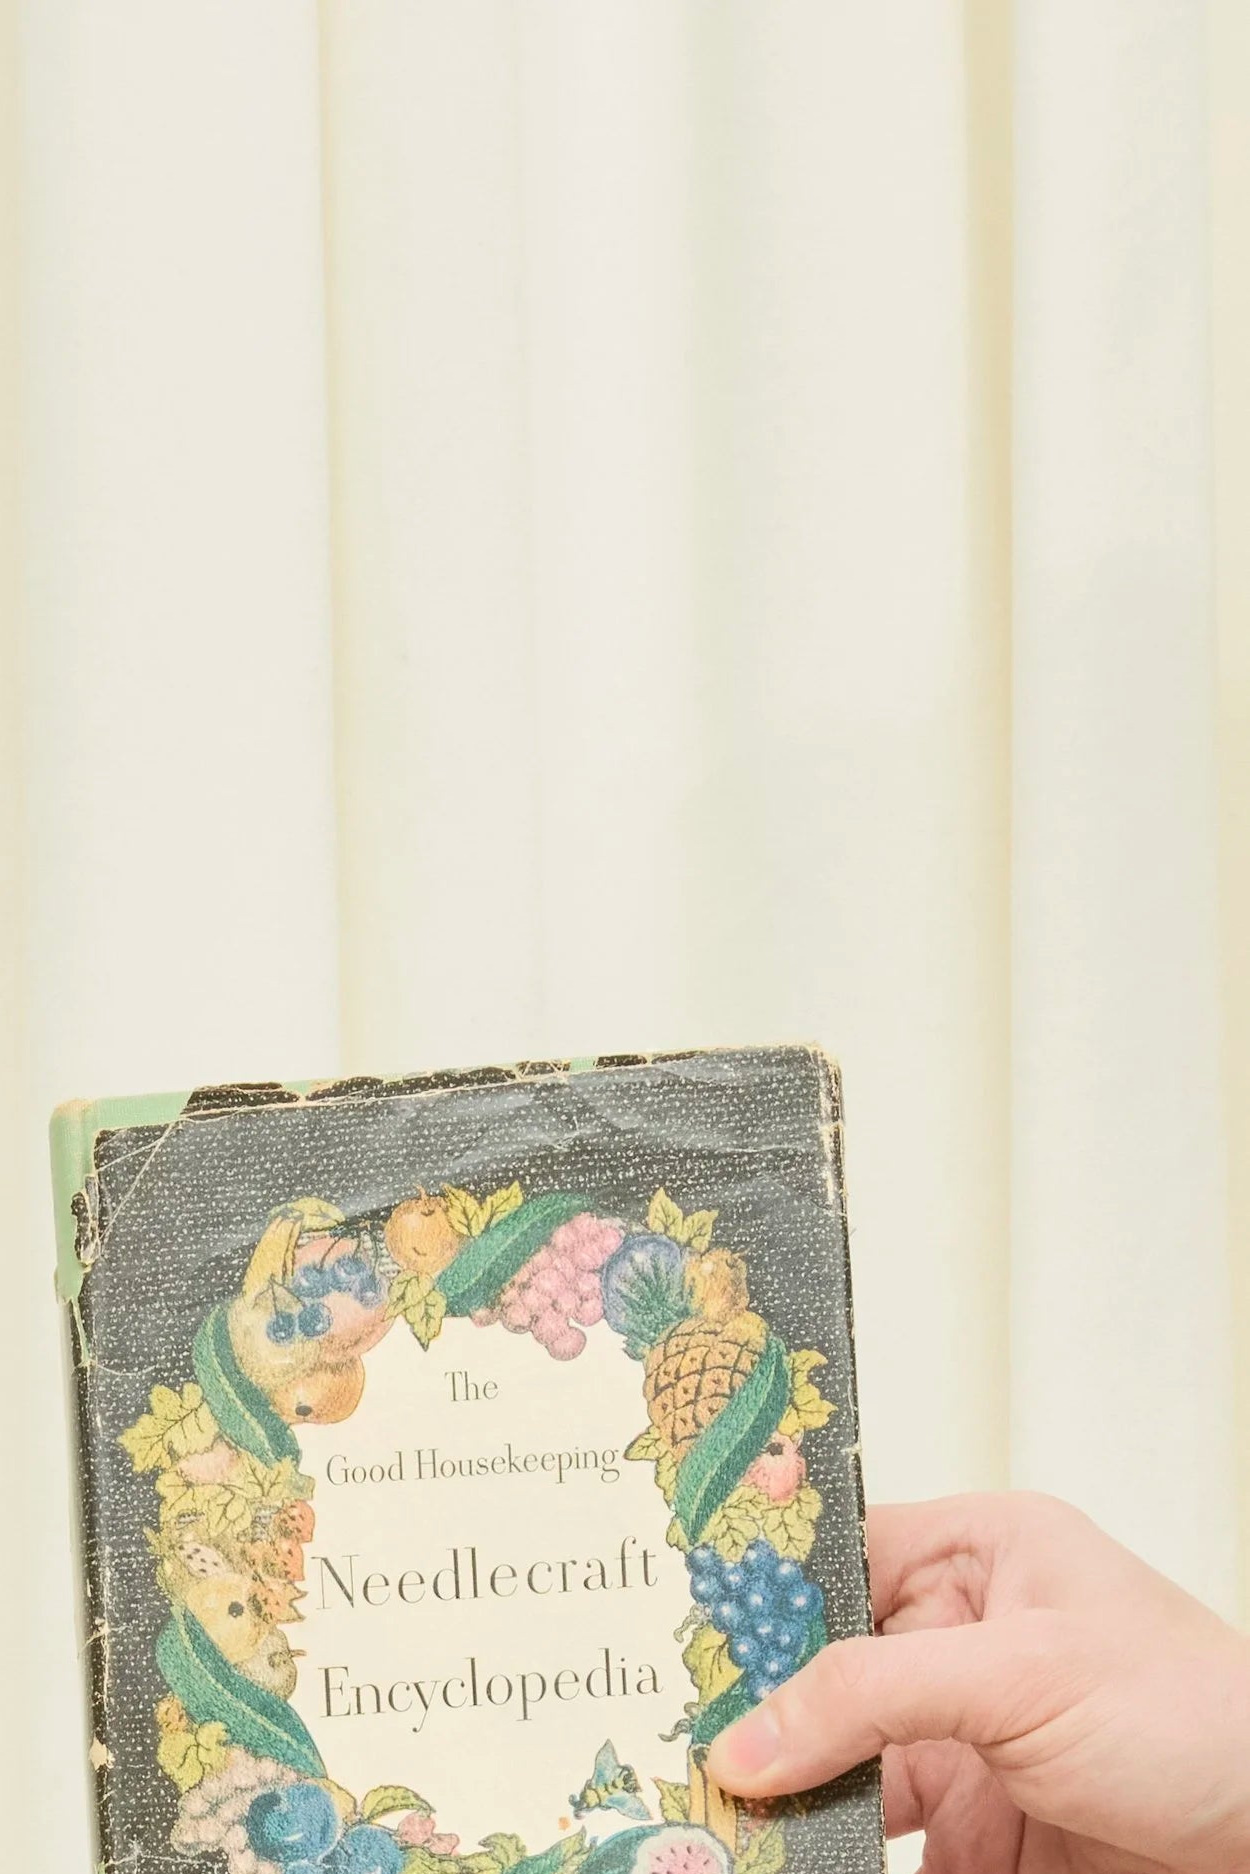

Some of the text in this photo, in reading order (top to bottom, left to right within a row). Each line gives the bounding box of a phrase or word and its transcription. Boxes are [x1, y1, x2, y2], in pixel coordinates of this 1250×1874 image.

[444, 1370, 499, 1403] The
[325, 1443, 620, 1485] Good Housekeeping
[311, 1536, 658, 1610] Needlecraft
[317, 1647, 663, 1734] Encyclopedia
